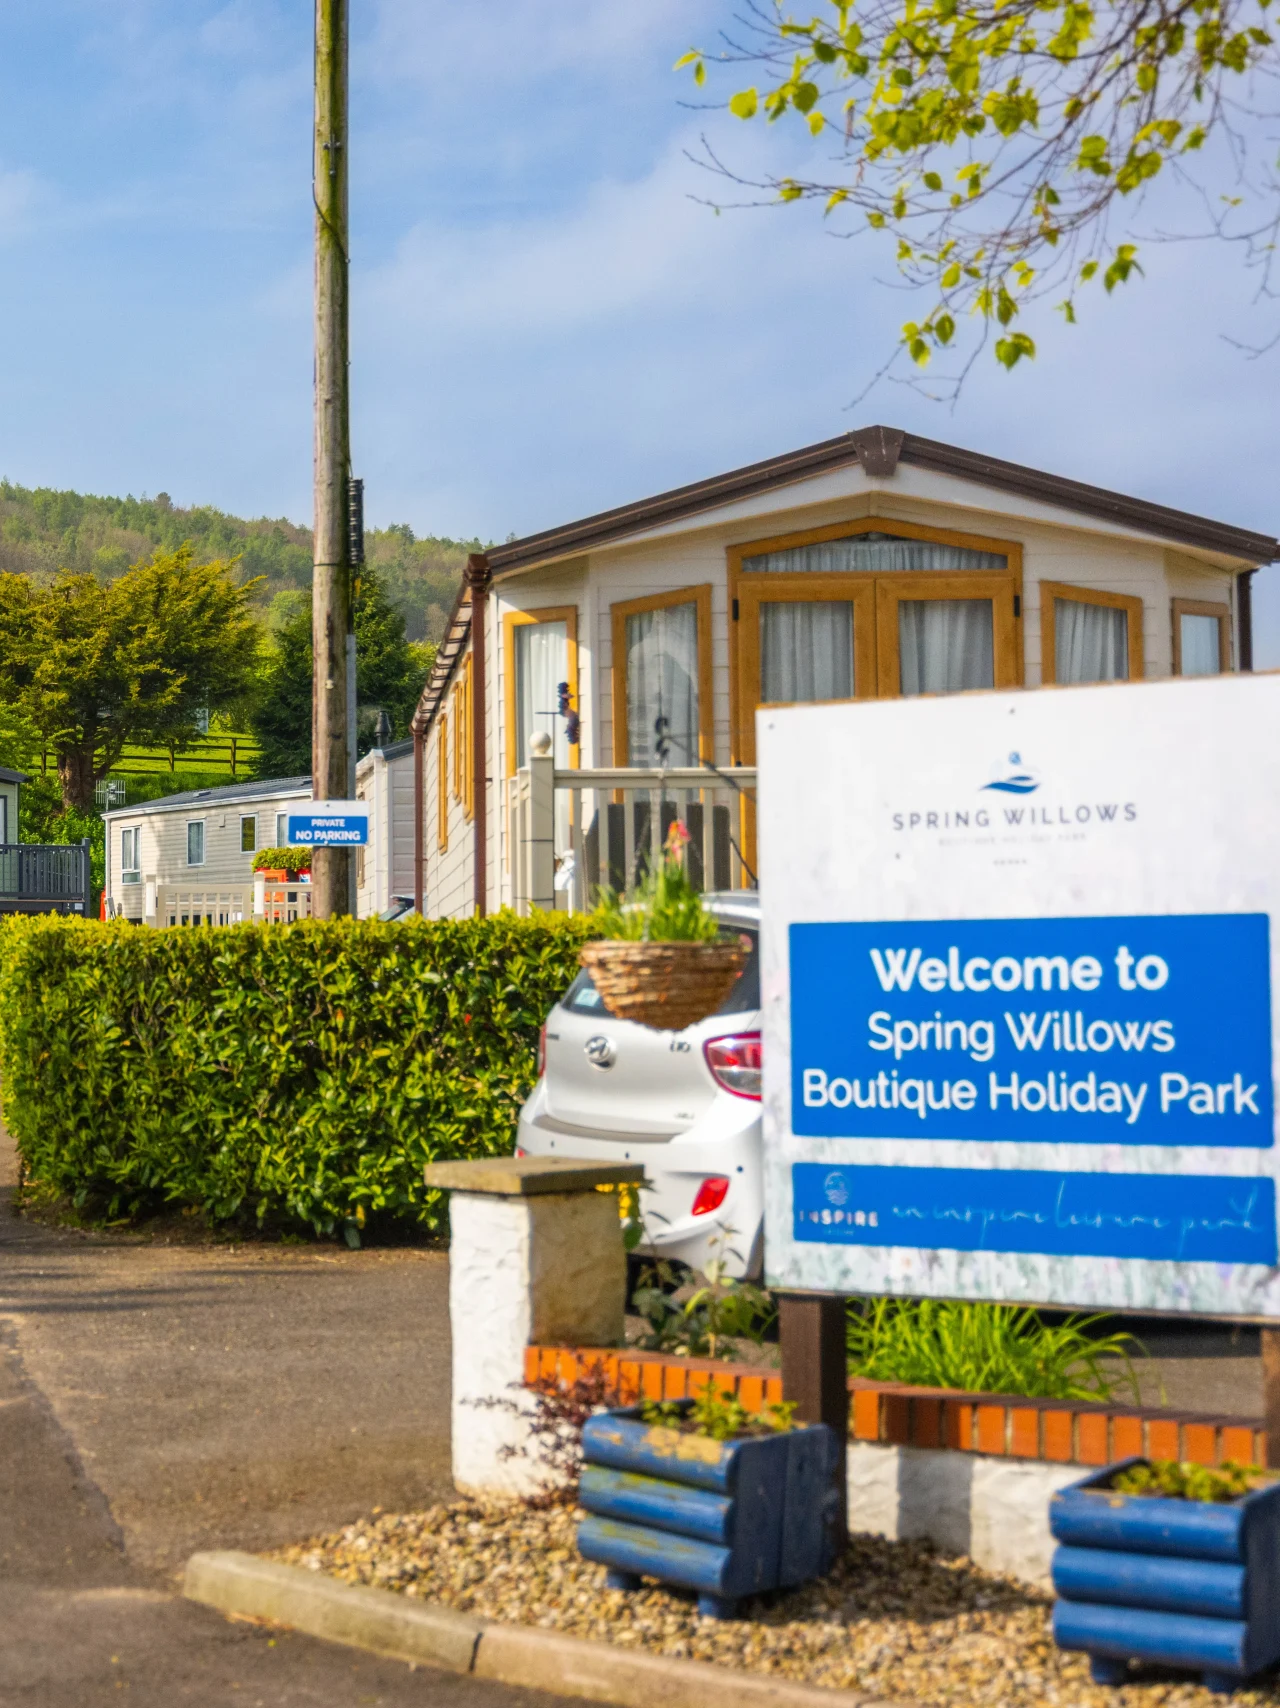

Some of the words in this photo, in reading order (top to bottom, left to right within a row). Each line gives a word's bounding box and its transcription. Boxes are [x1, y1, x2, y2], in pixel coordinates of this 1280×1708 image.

[295, 830, 312, 840] NO
[314, 830, 361, 840] PARKING
[311, 818, 345, 827] PRIVATE
[892, 809, 990, 831] SPRING
[1003, 802, 1138, 826] WILLOWS
[870, 946, 1103, 993] Welcome
[1115, 945, 1169, 991] to
[867, 1011, 996, 1062] Spring
[1004, 1010, 1175, 1053] Willows
[802, 1068, 978, 1119] Boutique
[988, 1070, 1147, 1124] Holiday
[1159, 1072, 1260, 1115] Park
